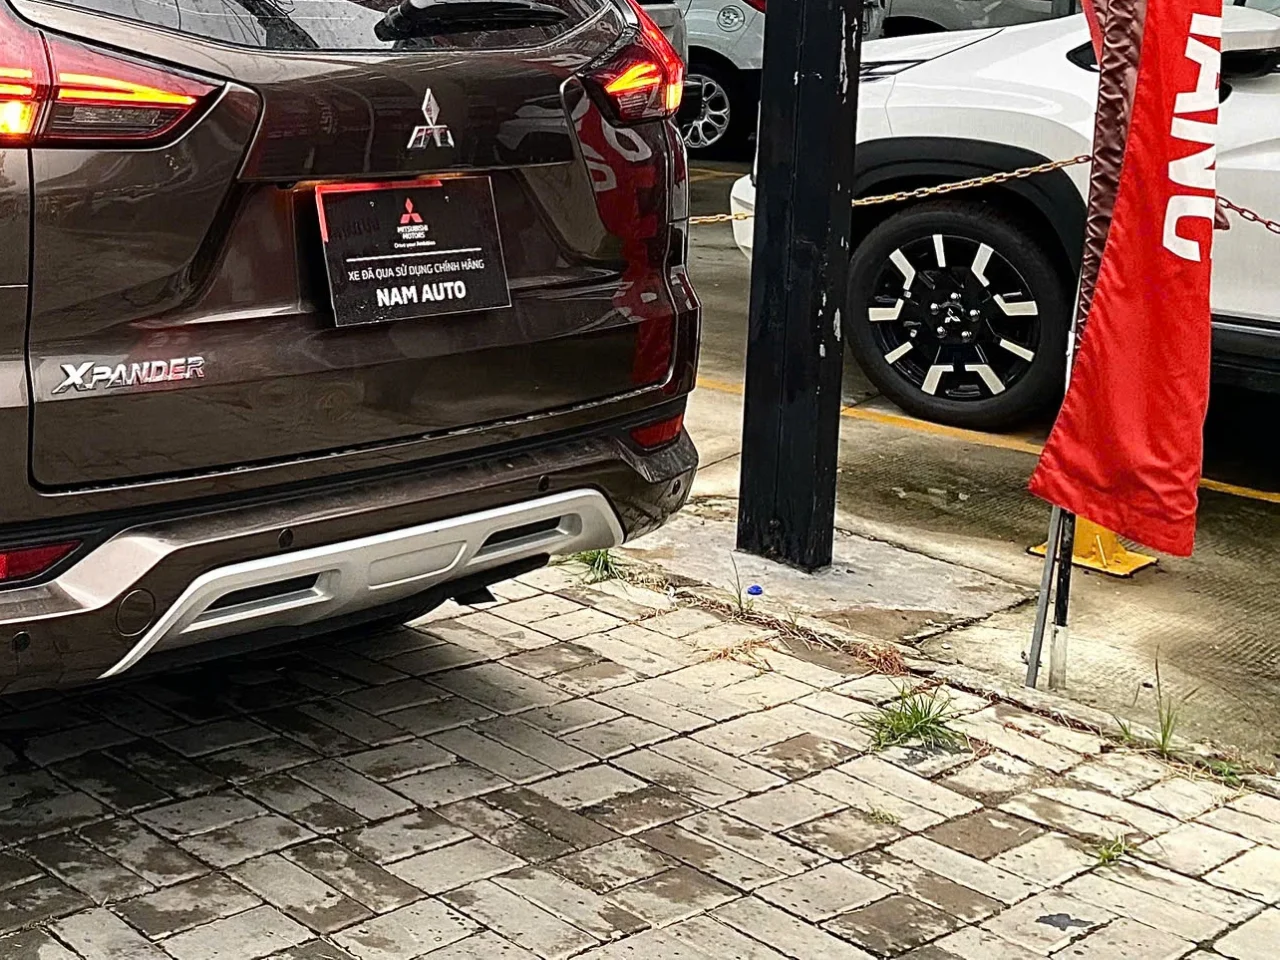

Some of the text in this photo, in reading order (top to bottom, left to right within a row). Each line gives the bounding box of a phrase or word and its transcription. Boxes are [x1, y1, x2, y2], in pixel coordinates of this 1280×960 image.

[396, 224, 429, 233] MITSUBISHI
[402, 231, 426, 240] MOTORS
[348, 269, 360, 282] XE
[361, 267, 375, 281] ĐÃ
[375, 266, 395, 280] QUA
[408, 263, 434, 278] DỤNG
[434, 259, 461, 273] CHÍNH
[376, 280, 468, 307] NAM AUTO
[52, 356, 206, 394] XPANDER
